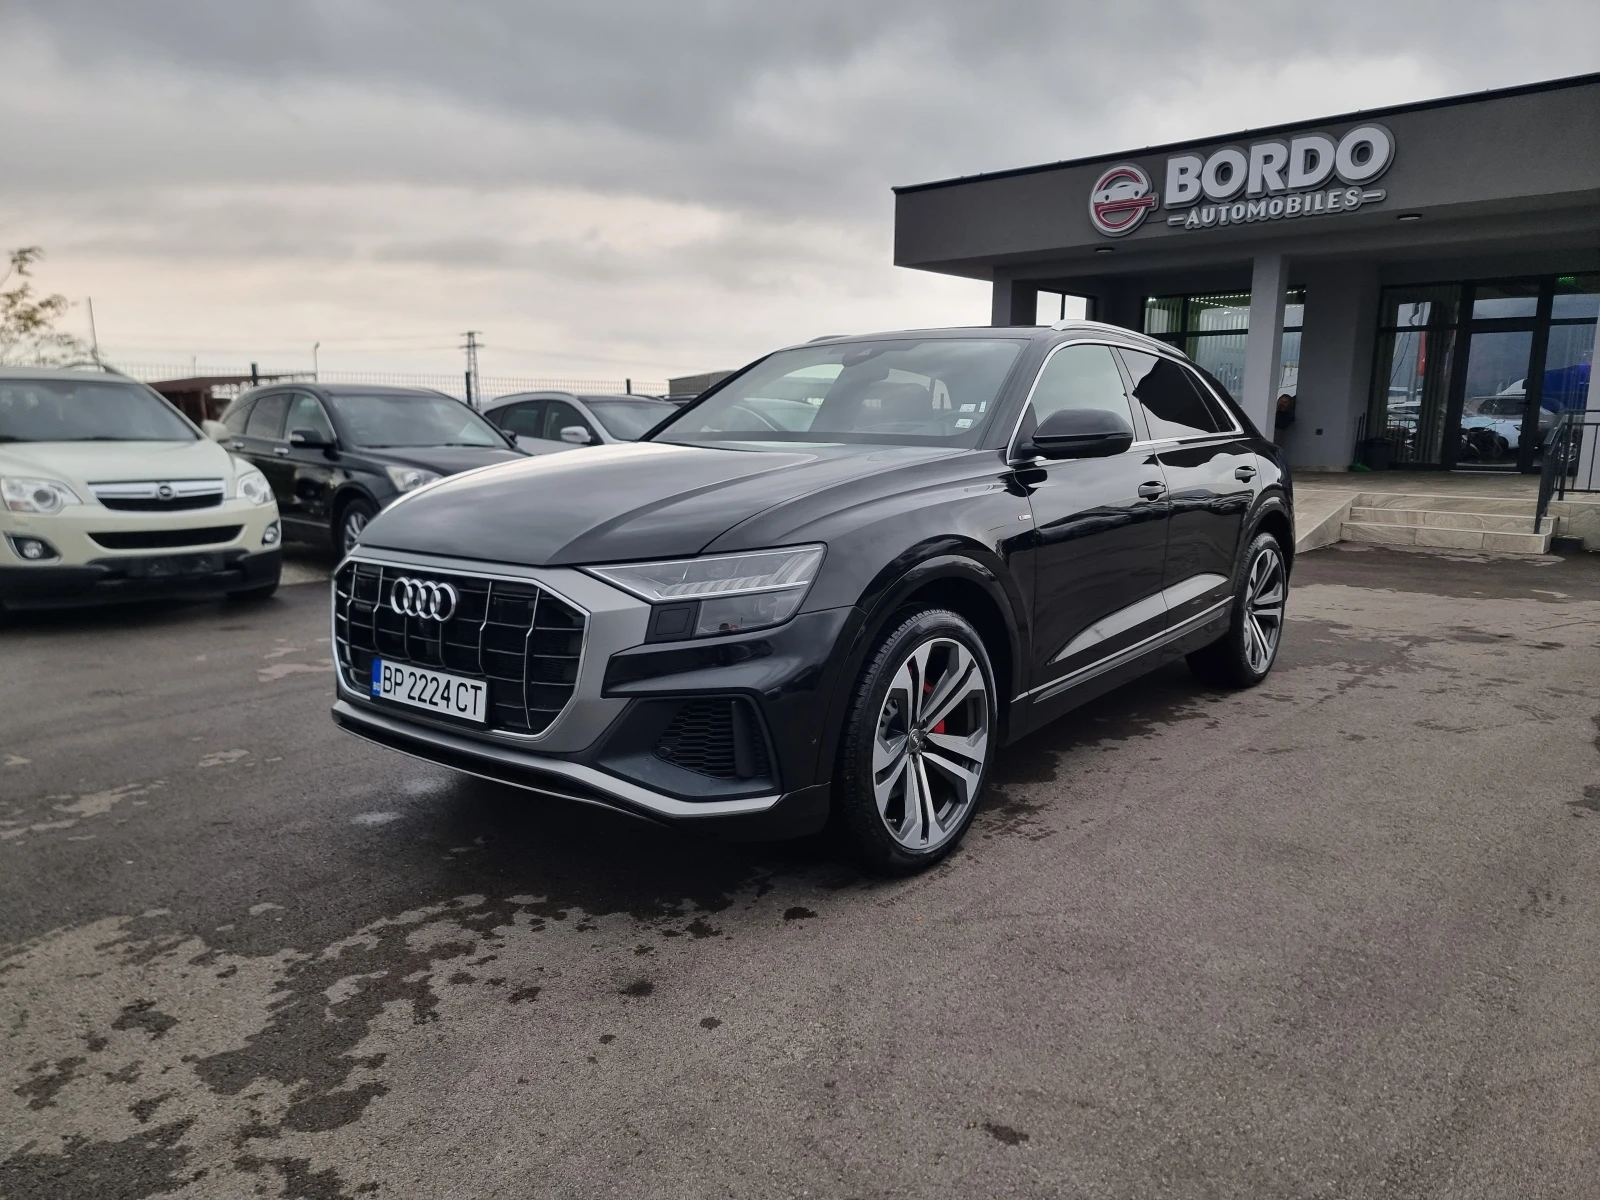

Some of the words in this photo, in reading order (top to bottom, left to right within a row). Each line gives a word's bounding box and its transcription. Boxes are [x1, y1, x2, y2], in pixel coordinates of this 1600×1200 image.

[1165, 126, 1390, 205] BORDO
[382, 665, 404, 696] BP
[407, 671, 451, 709] 2224
[456, 682, 483, 716] CT
